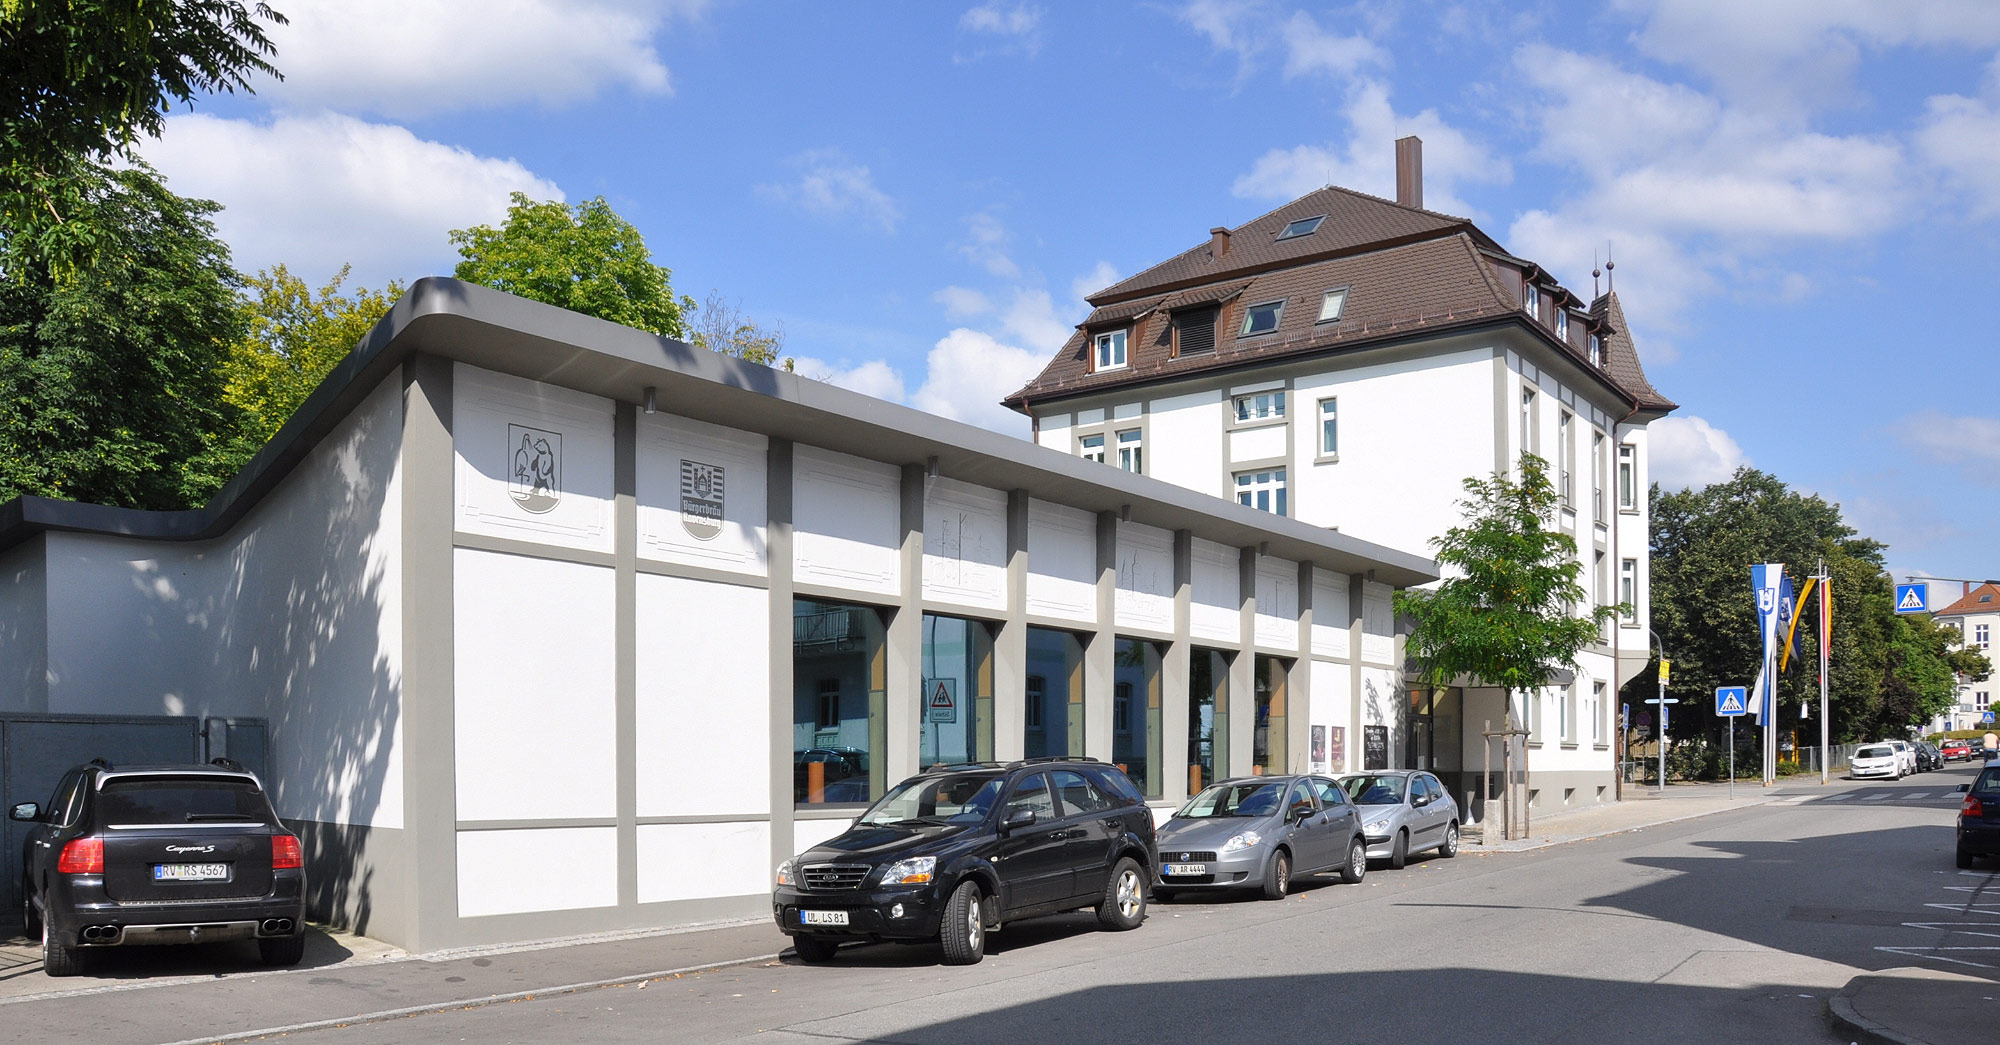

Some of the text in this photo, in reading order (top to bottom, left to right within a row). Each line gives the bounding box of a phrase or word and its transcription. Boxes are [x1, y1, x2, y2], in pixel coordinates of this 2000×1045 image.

[165, 845, 216, 854] Cayenne S
[163, 865, 225, 876] RV RS 4567
[807, 913, 845, 923] UL LS 81
